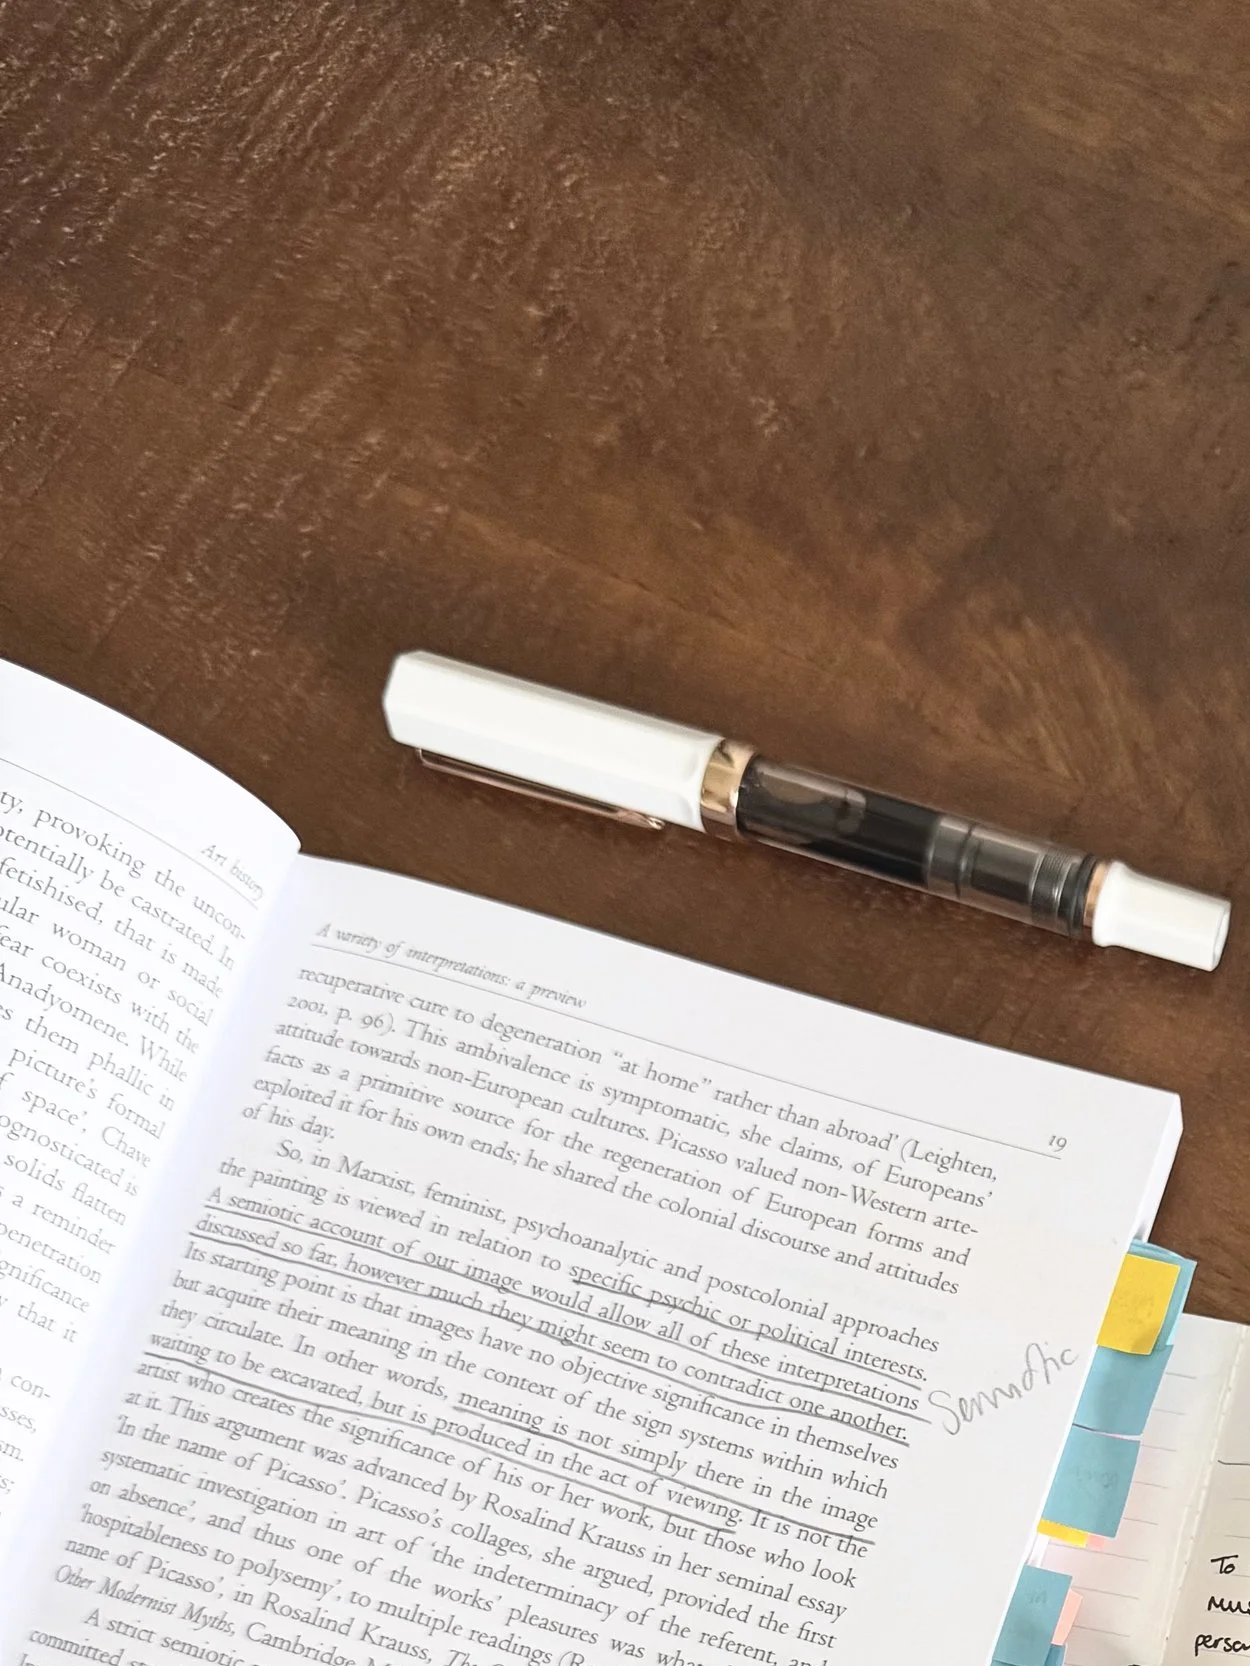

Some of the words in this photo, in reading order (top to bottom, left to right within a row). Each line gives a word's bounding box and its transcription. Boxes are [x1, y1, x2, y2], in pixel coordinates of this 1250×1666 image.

[52, 922, 127, 972] woman
[127, 895, 215, 956] castrated.
[40, 955, 123, 1005] coexists
[349, 1040, 421, 1070] towards
[425, 1063, 564, 1115] non-European
[569, 1103, 649, 1142] cultures.
[655, 1127, 728, 1165] Picasso
[736, 1156, 799, 1186] valued
[800, 1178, 933, 1224] non-Western
[455, 1039, 572, 1085] ambivalence
[601, 1086, 731, 1137] symptomatic,
[779, 1136, 843, 1171] claims,
[479, 1012, 603, 1064] degeneration
[713, 1089, 773, 1116] rather
[777, 1103, 820, 1131] than
[900, 1138, 997, 1183] (Leighten,
[451, 1102, 515, 1130] source
[764, 1191, 857, 1235] European
[866, 1221, 925, 1253] forms
[1048, 1134, 1068, 1153] 19
[656, 1196, 738, 1231] colonial
[739, 1217, 831, 1258] discourse
[874, 1261, 960, 1295] attitudes
[703, 1275, 829, 1321] postcolonial
[831, 1313, 940, 1353] approaches
[1210, 1554, 1240, 1577] To
